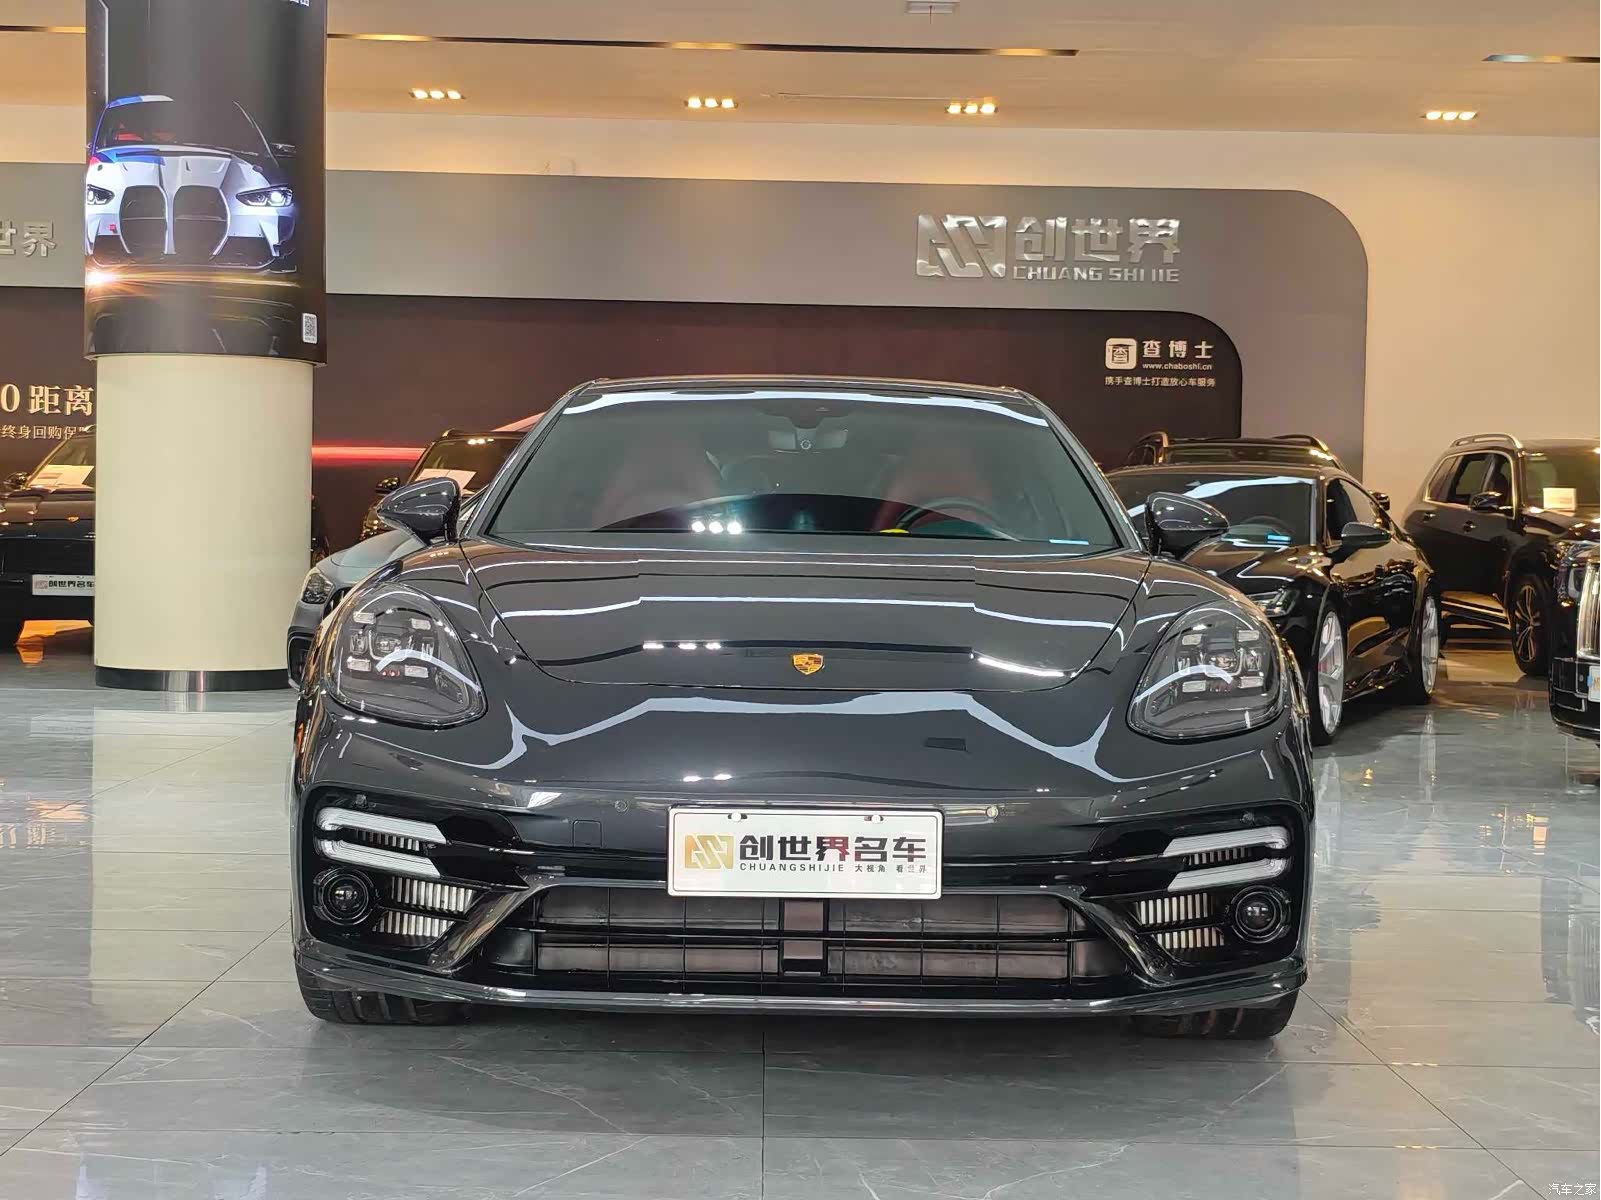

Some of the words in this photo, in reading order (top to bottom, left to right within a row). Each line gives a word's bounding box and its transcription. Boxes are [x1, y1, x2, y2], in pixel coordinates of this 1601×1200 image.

[1015, 216, 1181, 264] 创世界
[1012, 265, 1103, 281] CHUANG
[1108, 267, 1144, 282] SHI
[1142, 340, 1214, 359] 查博士
[1142, 362, 1213, 371] www.chaboshi.cn
[1105, 376, 1216, 388] 携手查博士打造放心车服务
[739, 835, 927, 863] 创世界名车
[739, 862, 845, 873] CHUANGSHIJIE
[854, 863, 886, 873] 大视角
